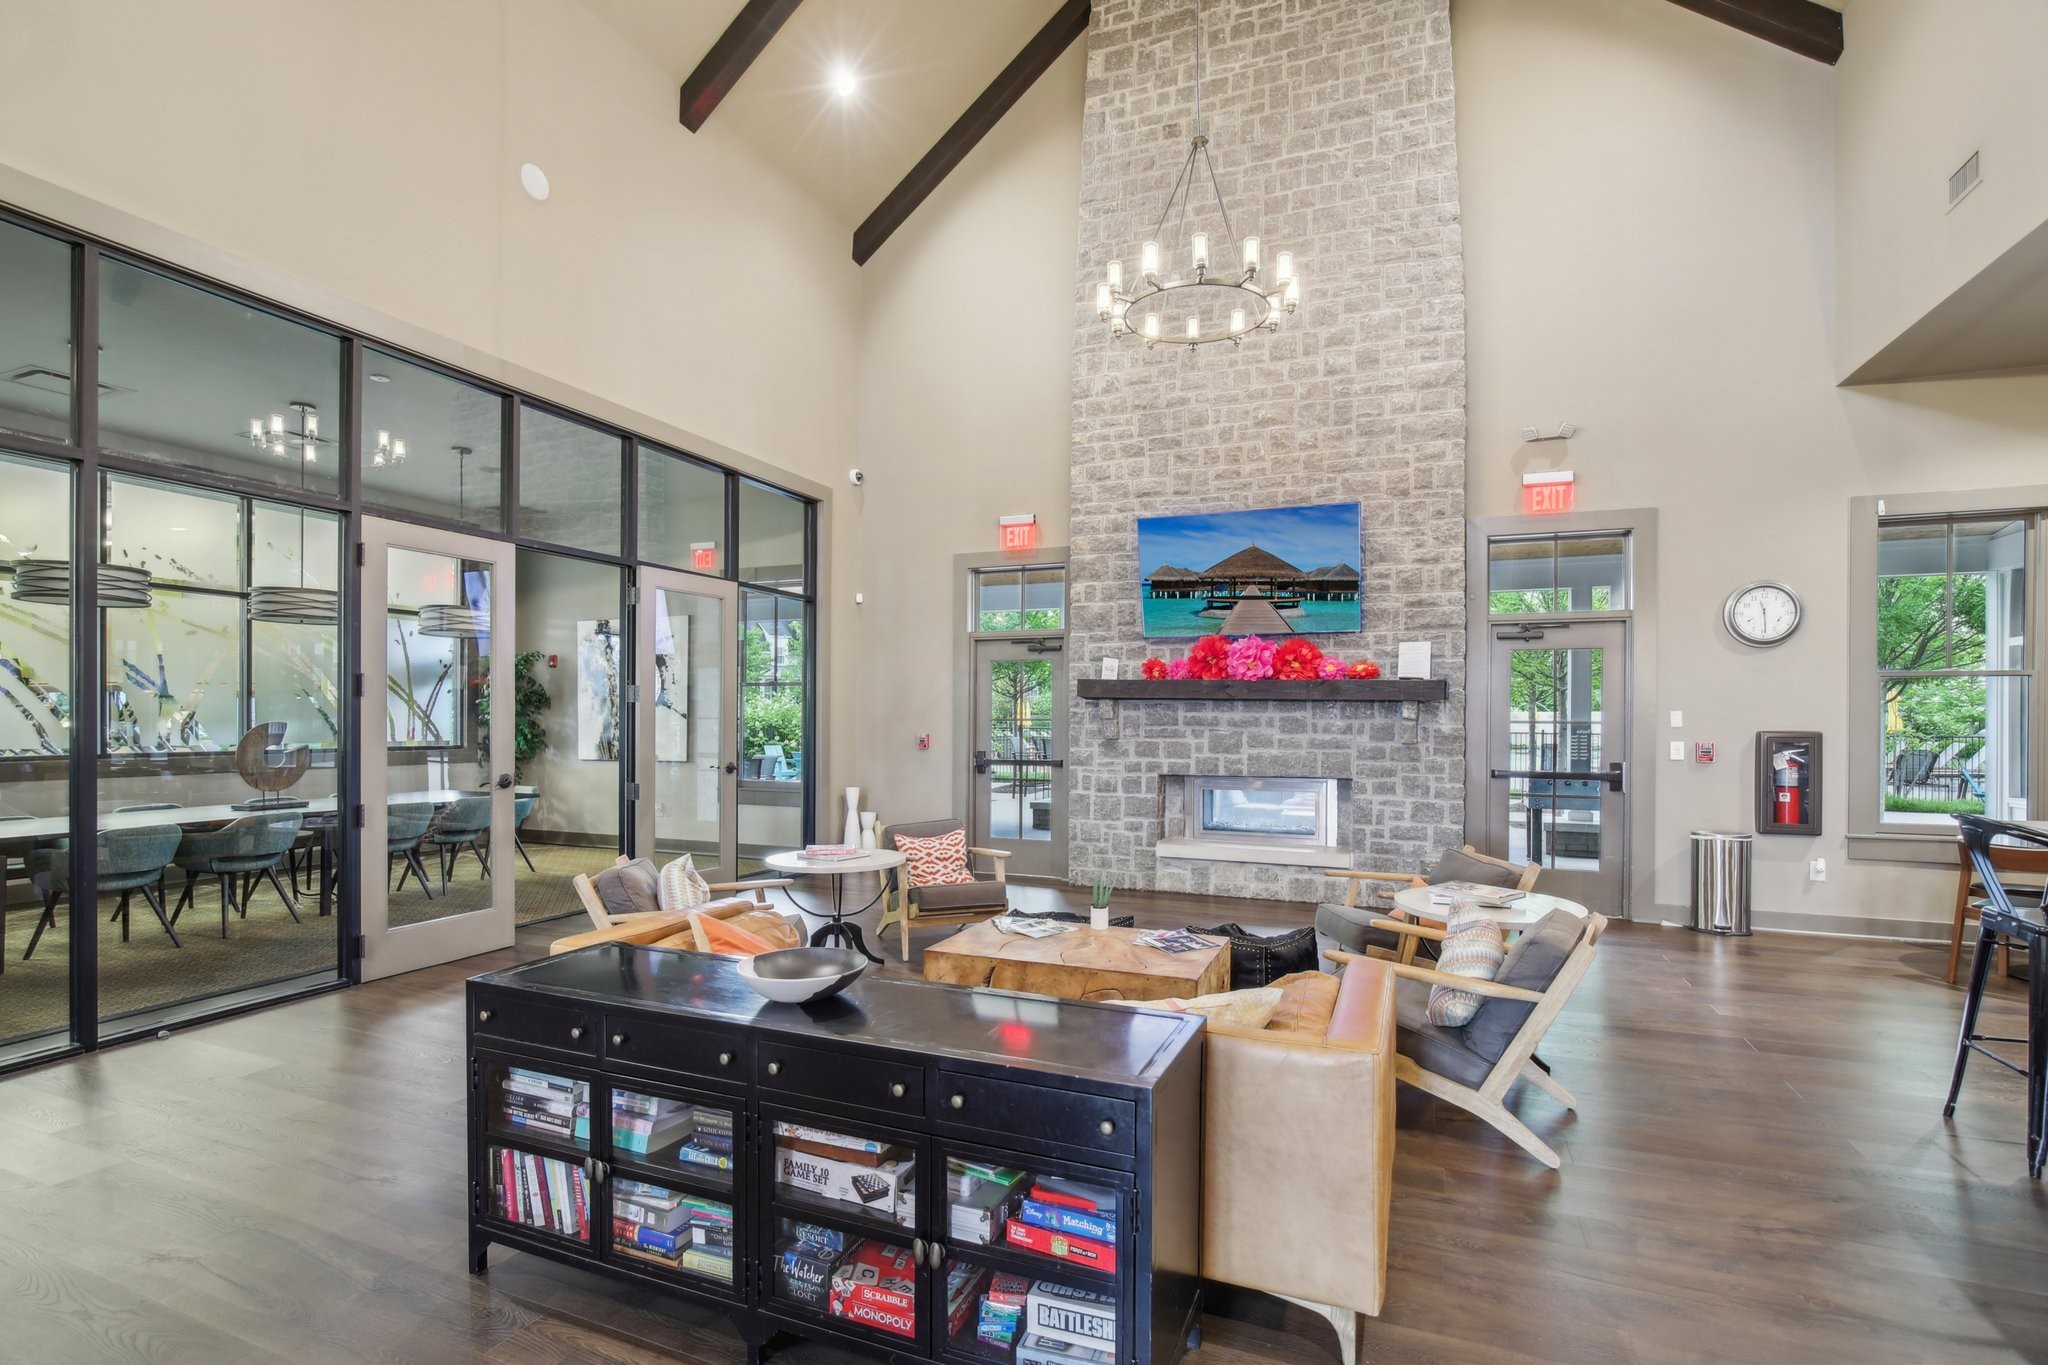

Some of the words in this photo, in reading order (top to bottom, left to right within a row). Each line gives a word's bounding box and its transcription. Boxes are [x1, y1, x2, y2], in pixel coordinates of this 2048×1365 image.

[1532, 485, 1566, 510] EXIT
[1006, 526, 1030, 547] EXIT
[783, 1158, 817, 1174] FAMILY
[820, 1167, 830, 1177] 10
[783, 1166, 811, 1181] GAME
[812, 1174, 830, 1186] SET
[1024, 1206, 1043, 1219] Disney
[796, 1226, 829, 1245] RESORT
[1062, 1215, 1104, 1236] Matching
[773, 1254, 789, 1274] The
[791, 1257, 824, 1283] Watcher
[863, 1289, 909, 1308] SCRABBLE
[853, 1306, 912, 1331] MONOPOLY
[1039, 1305, 1115, 1340] BATTLESH
